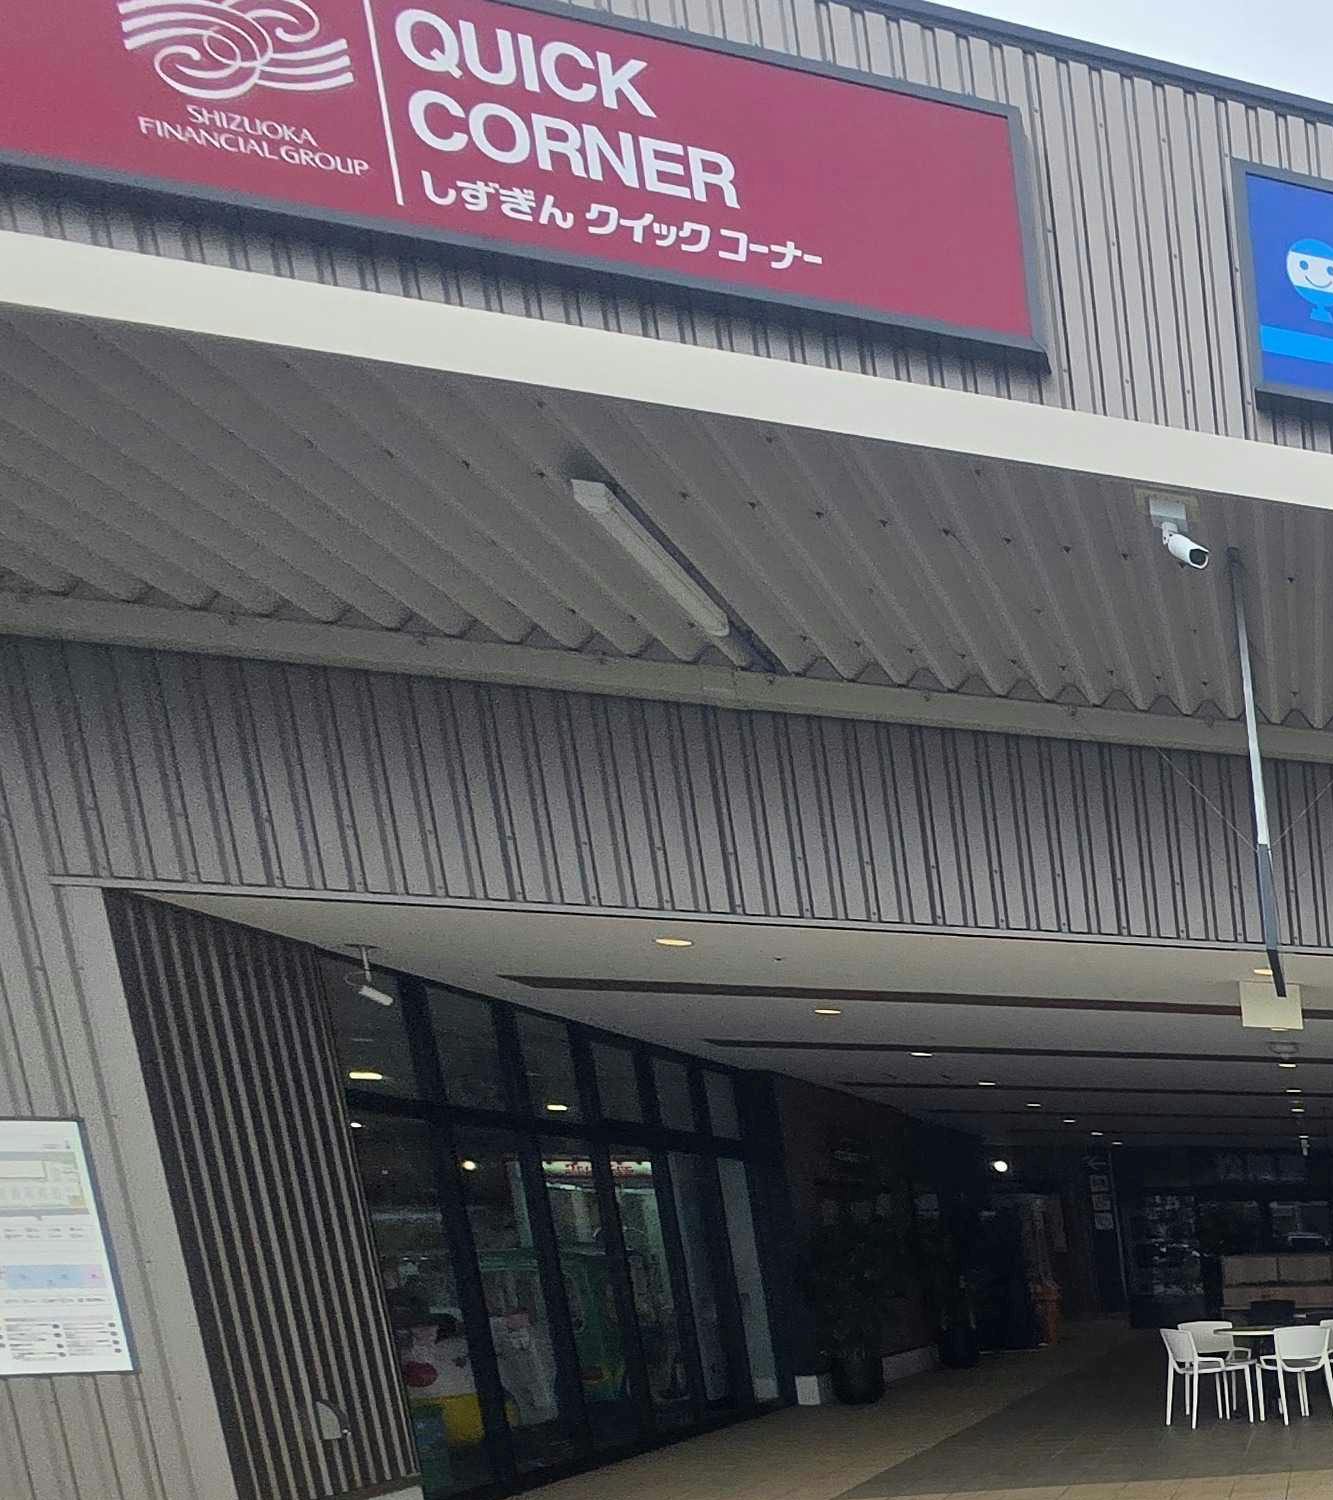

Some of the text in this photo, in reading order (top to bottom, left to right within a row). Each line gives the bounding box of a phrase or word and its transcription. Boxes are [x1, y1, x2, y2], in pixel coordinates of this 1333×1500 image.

[396, 9, 656, 118] QUICK
[137, 116, 369, 178] FINANCIAL GROUP
[187, 104, 317, 147] SHIZUOKA
[408, 89, 738, 209] CORNER
[422, 170, 824, 272] しずぎん クイック コーナー
